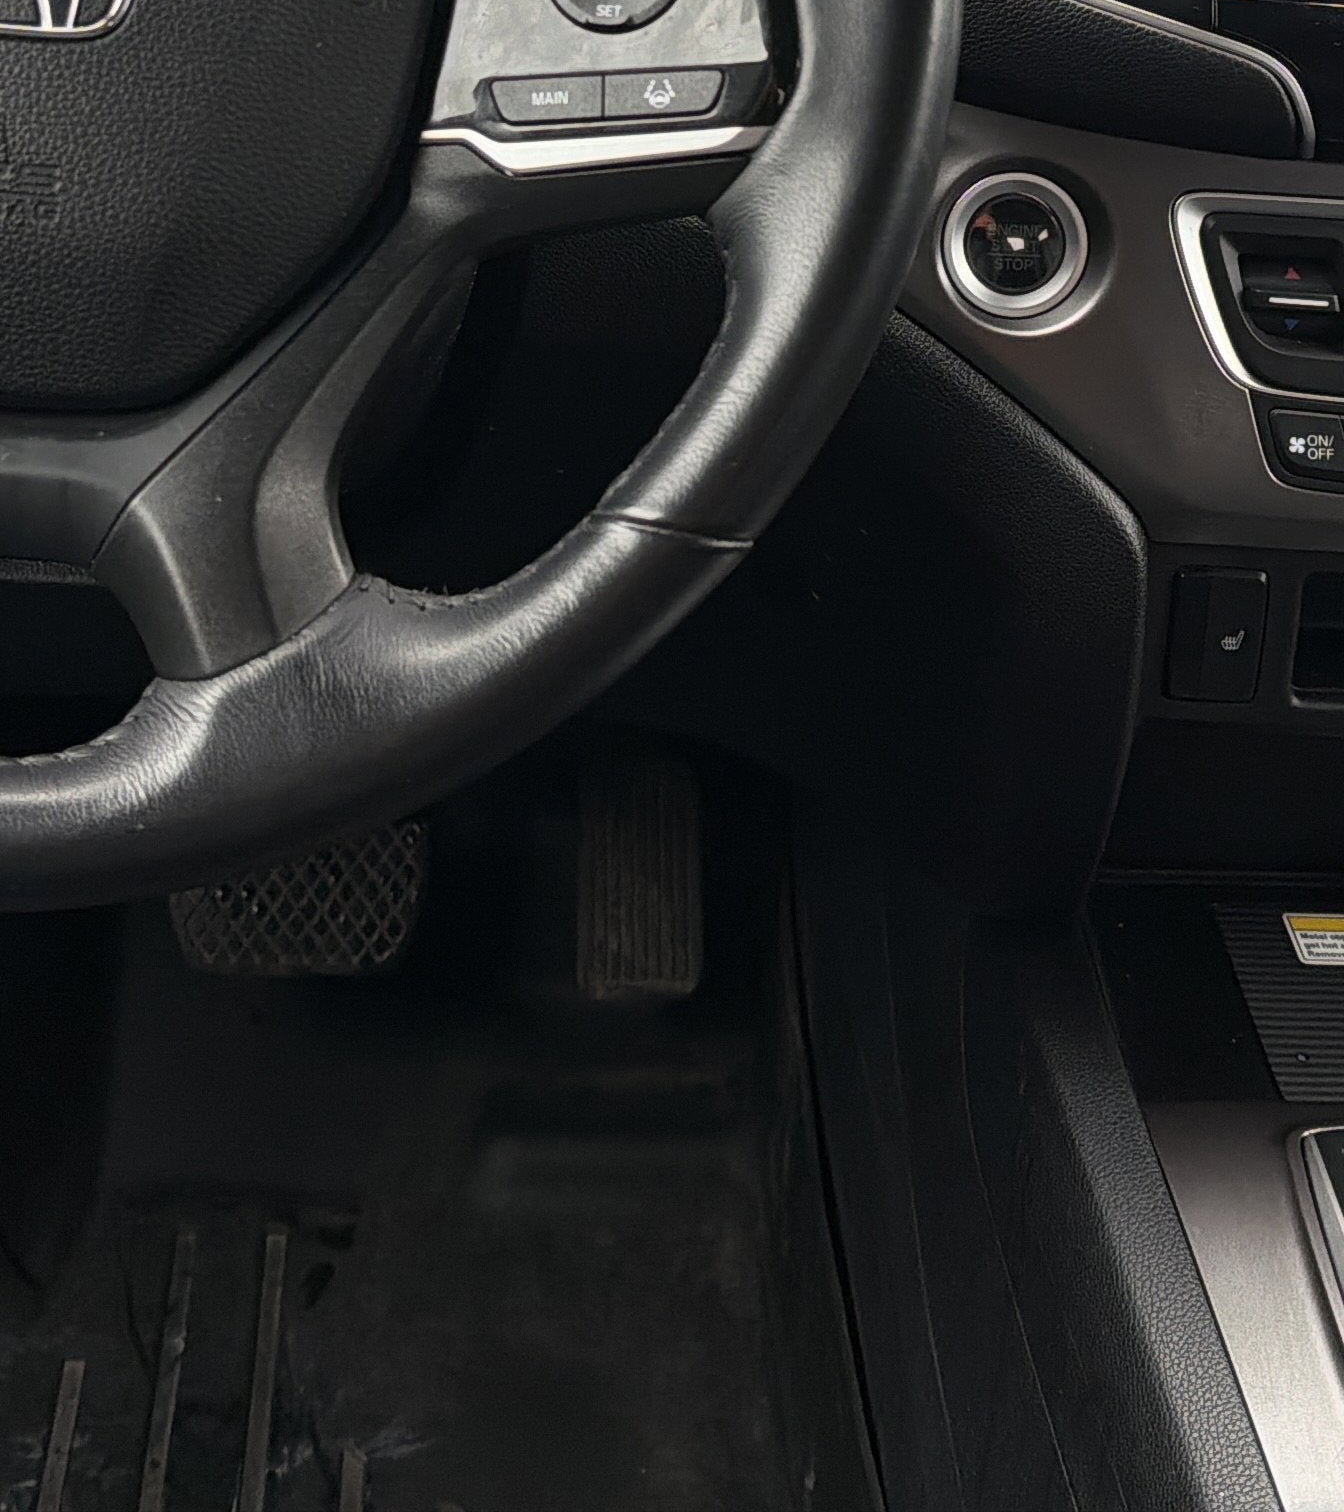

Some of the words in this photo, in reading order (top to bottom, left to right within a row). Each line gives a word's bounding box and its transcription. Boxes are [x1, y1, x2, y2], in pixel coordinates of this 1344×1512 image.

[595, 4, 623, 18] SET
[531, 90, 569, 106] MAIN
[994, 257, 1033, 271] STOP
[1307, 434, 1334, 448] ON/
[1307, 447, 1335, 461] OFF
